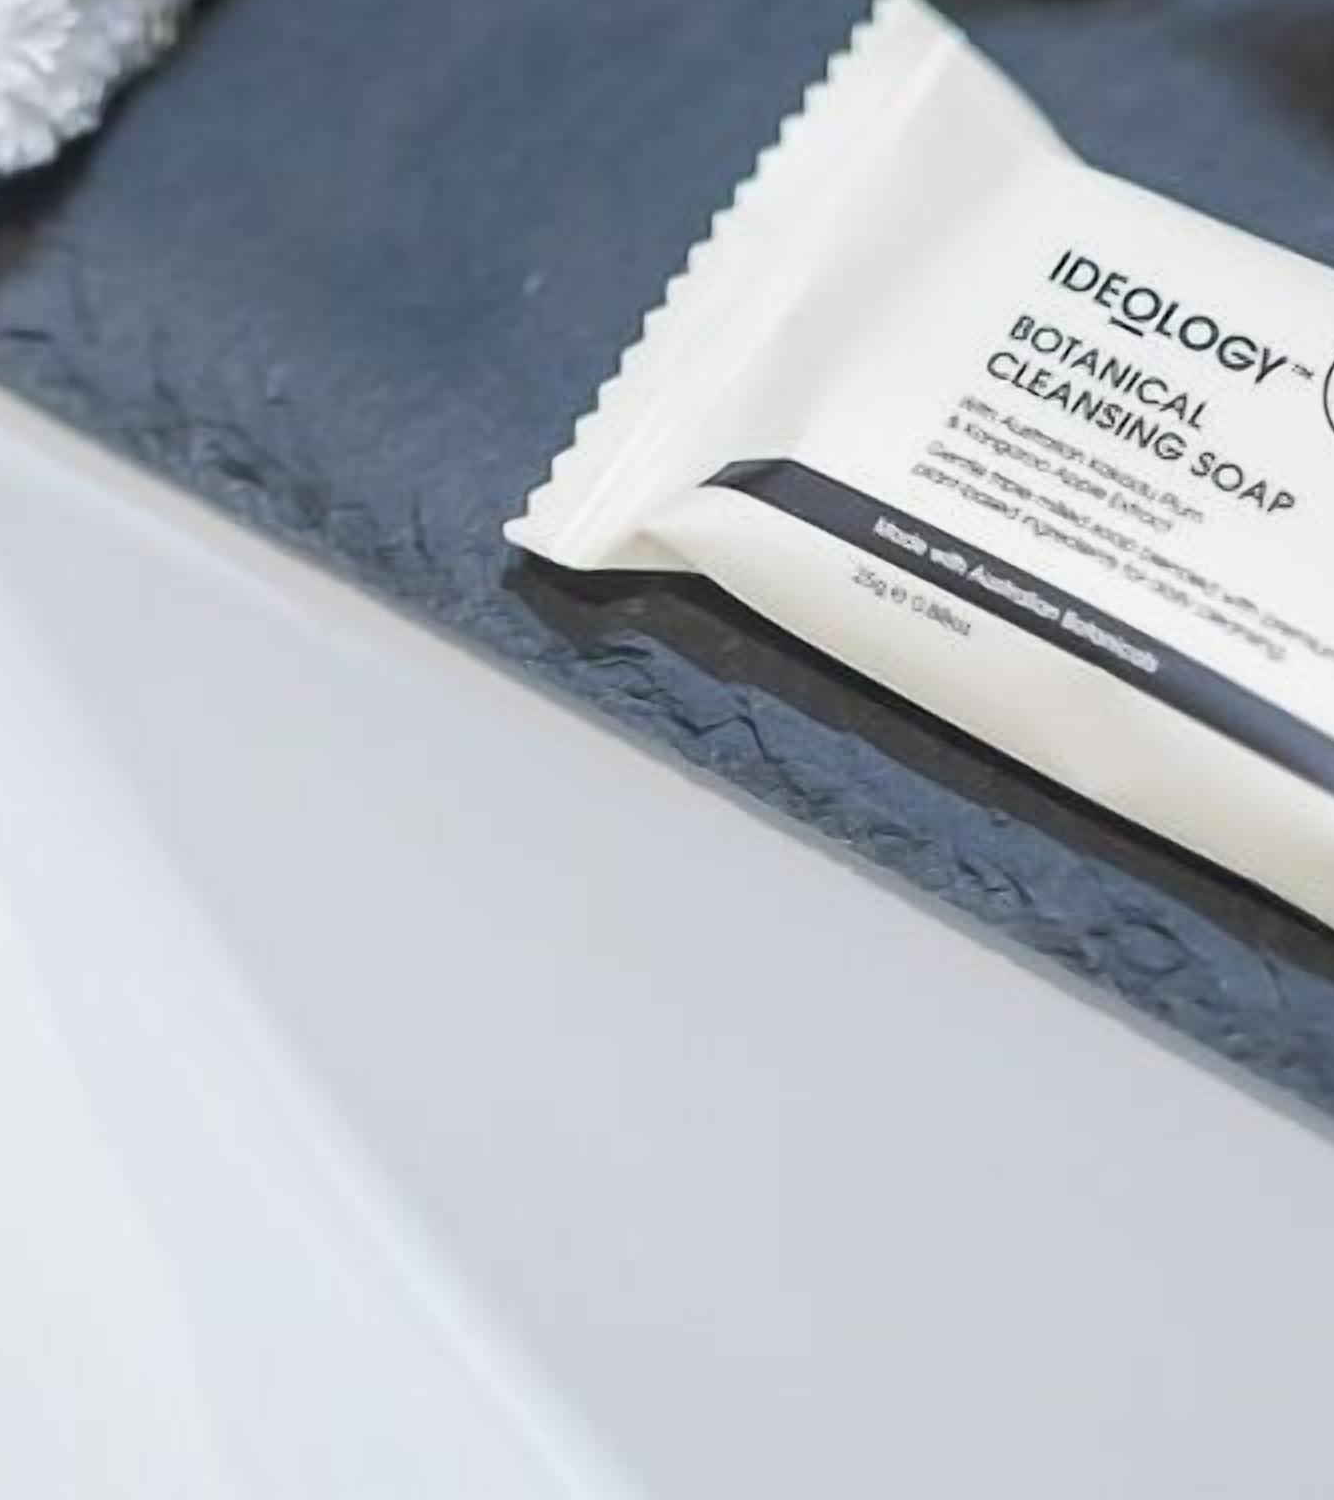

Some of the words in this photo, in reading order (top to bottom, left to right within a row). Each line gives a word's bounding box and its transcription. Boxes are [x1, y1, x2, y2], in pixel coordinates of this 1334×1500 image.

[985, 350, 1185, 463] CLEANSING
[1190, 450, 1298, 514] SOAP
[1010, 314, 1210, 431] BOTANICAL
